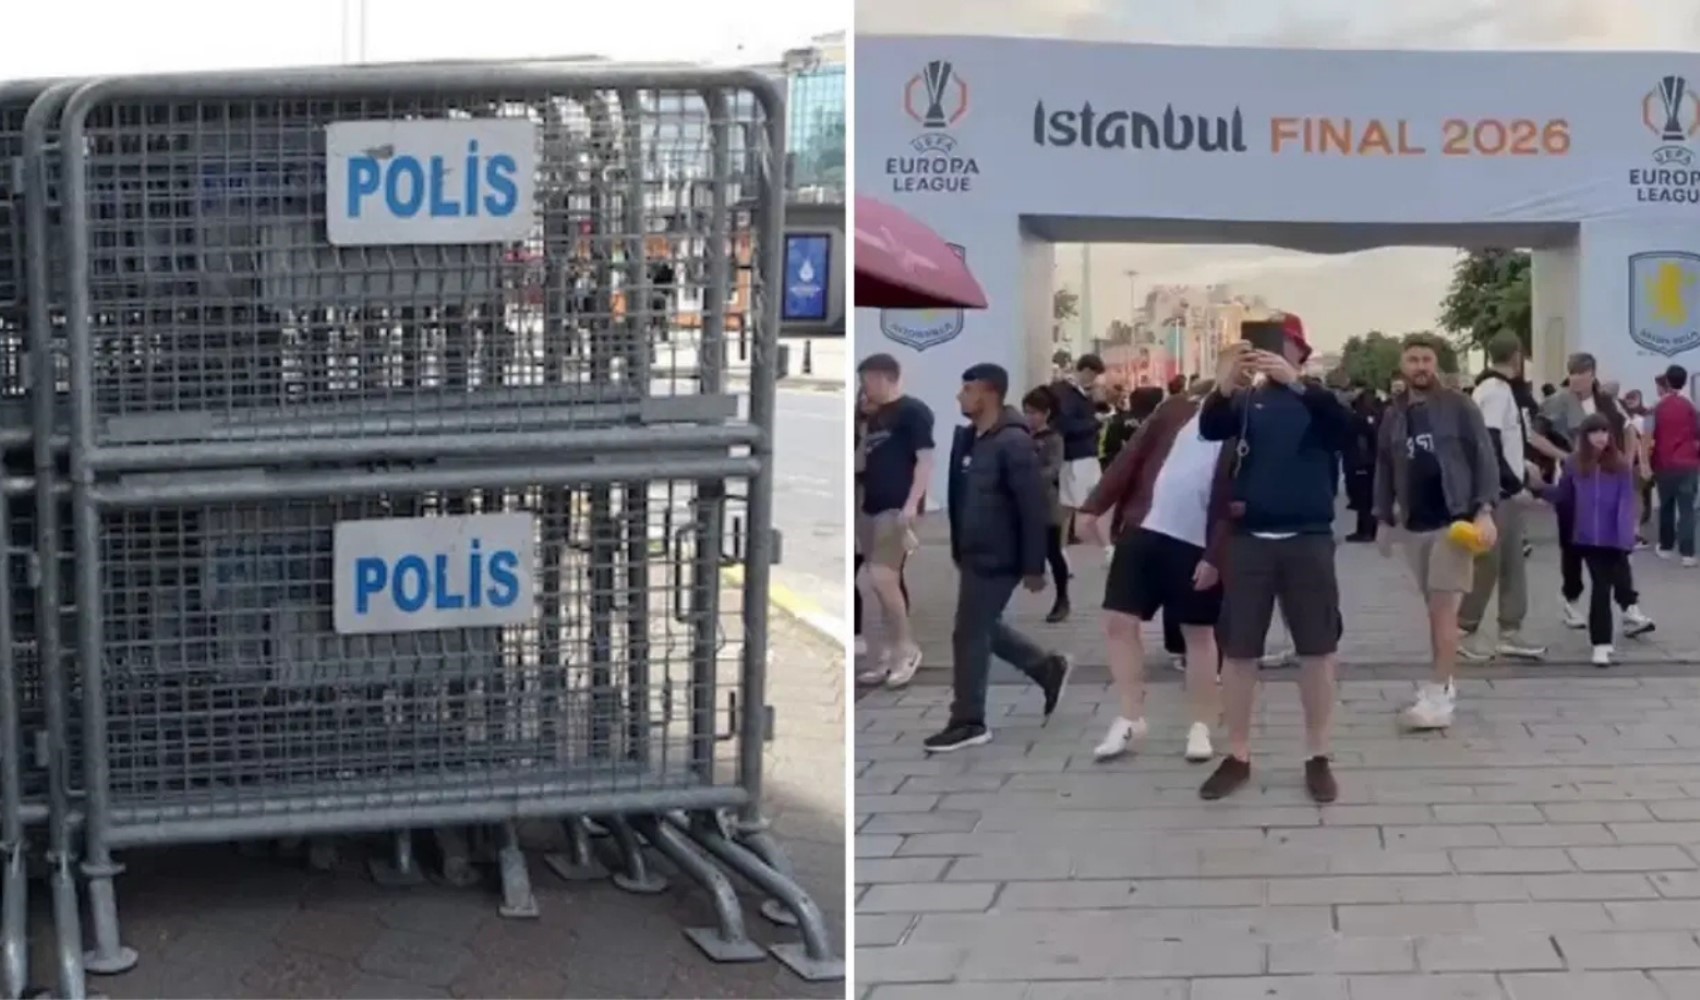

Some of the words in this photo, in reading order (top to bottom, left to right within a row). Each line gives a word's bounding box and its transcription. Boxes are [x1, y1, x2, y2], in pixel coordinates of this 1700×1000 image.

[1034, 98, 1247, 152] Istanbul
[1270, 117, 1426, 155] FINAL
[1442, 118, 1571, 155] 2026
[912, 136, 953, 152] UEFA
[886, 157, 979, 175] EUROPA
[347, 139, 518, 218] POLİS
[893, 177, 971, 192] LEAGUE
[1629, 169, 1700, 186] EUROP
[1637, 188, 1700, 203] LEAGU
[355, 538, 519, 614] POLİS
